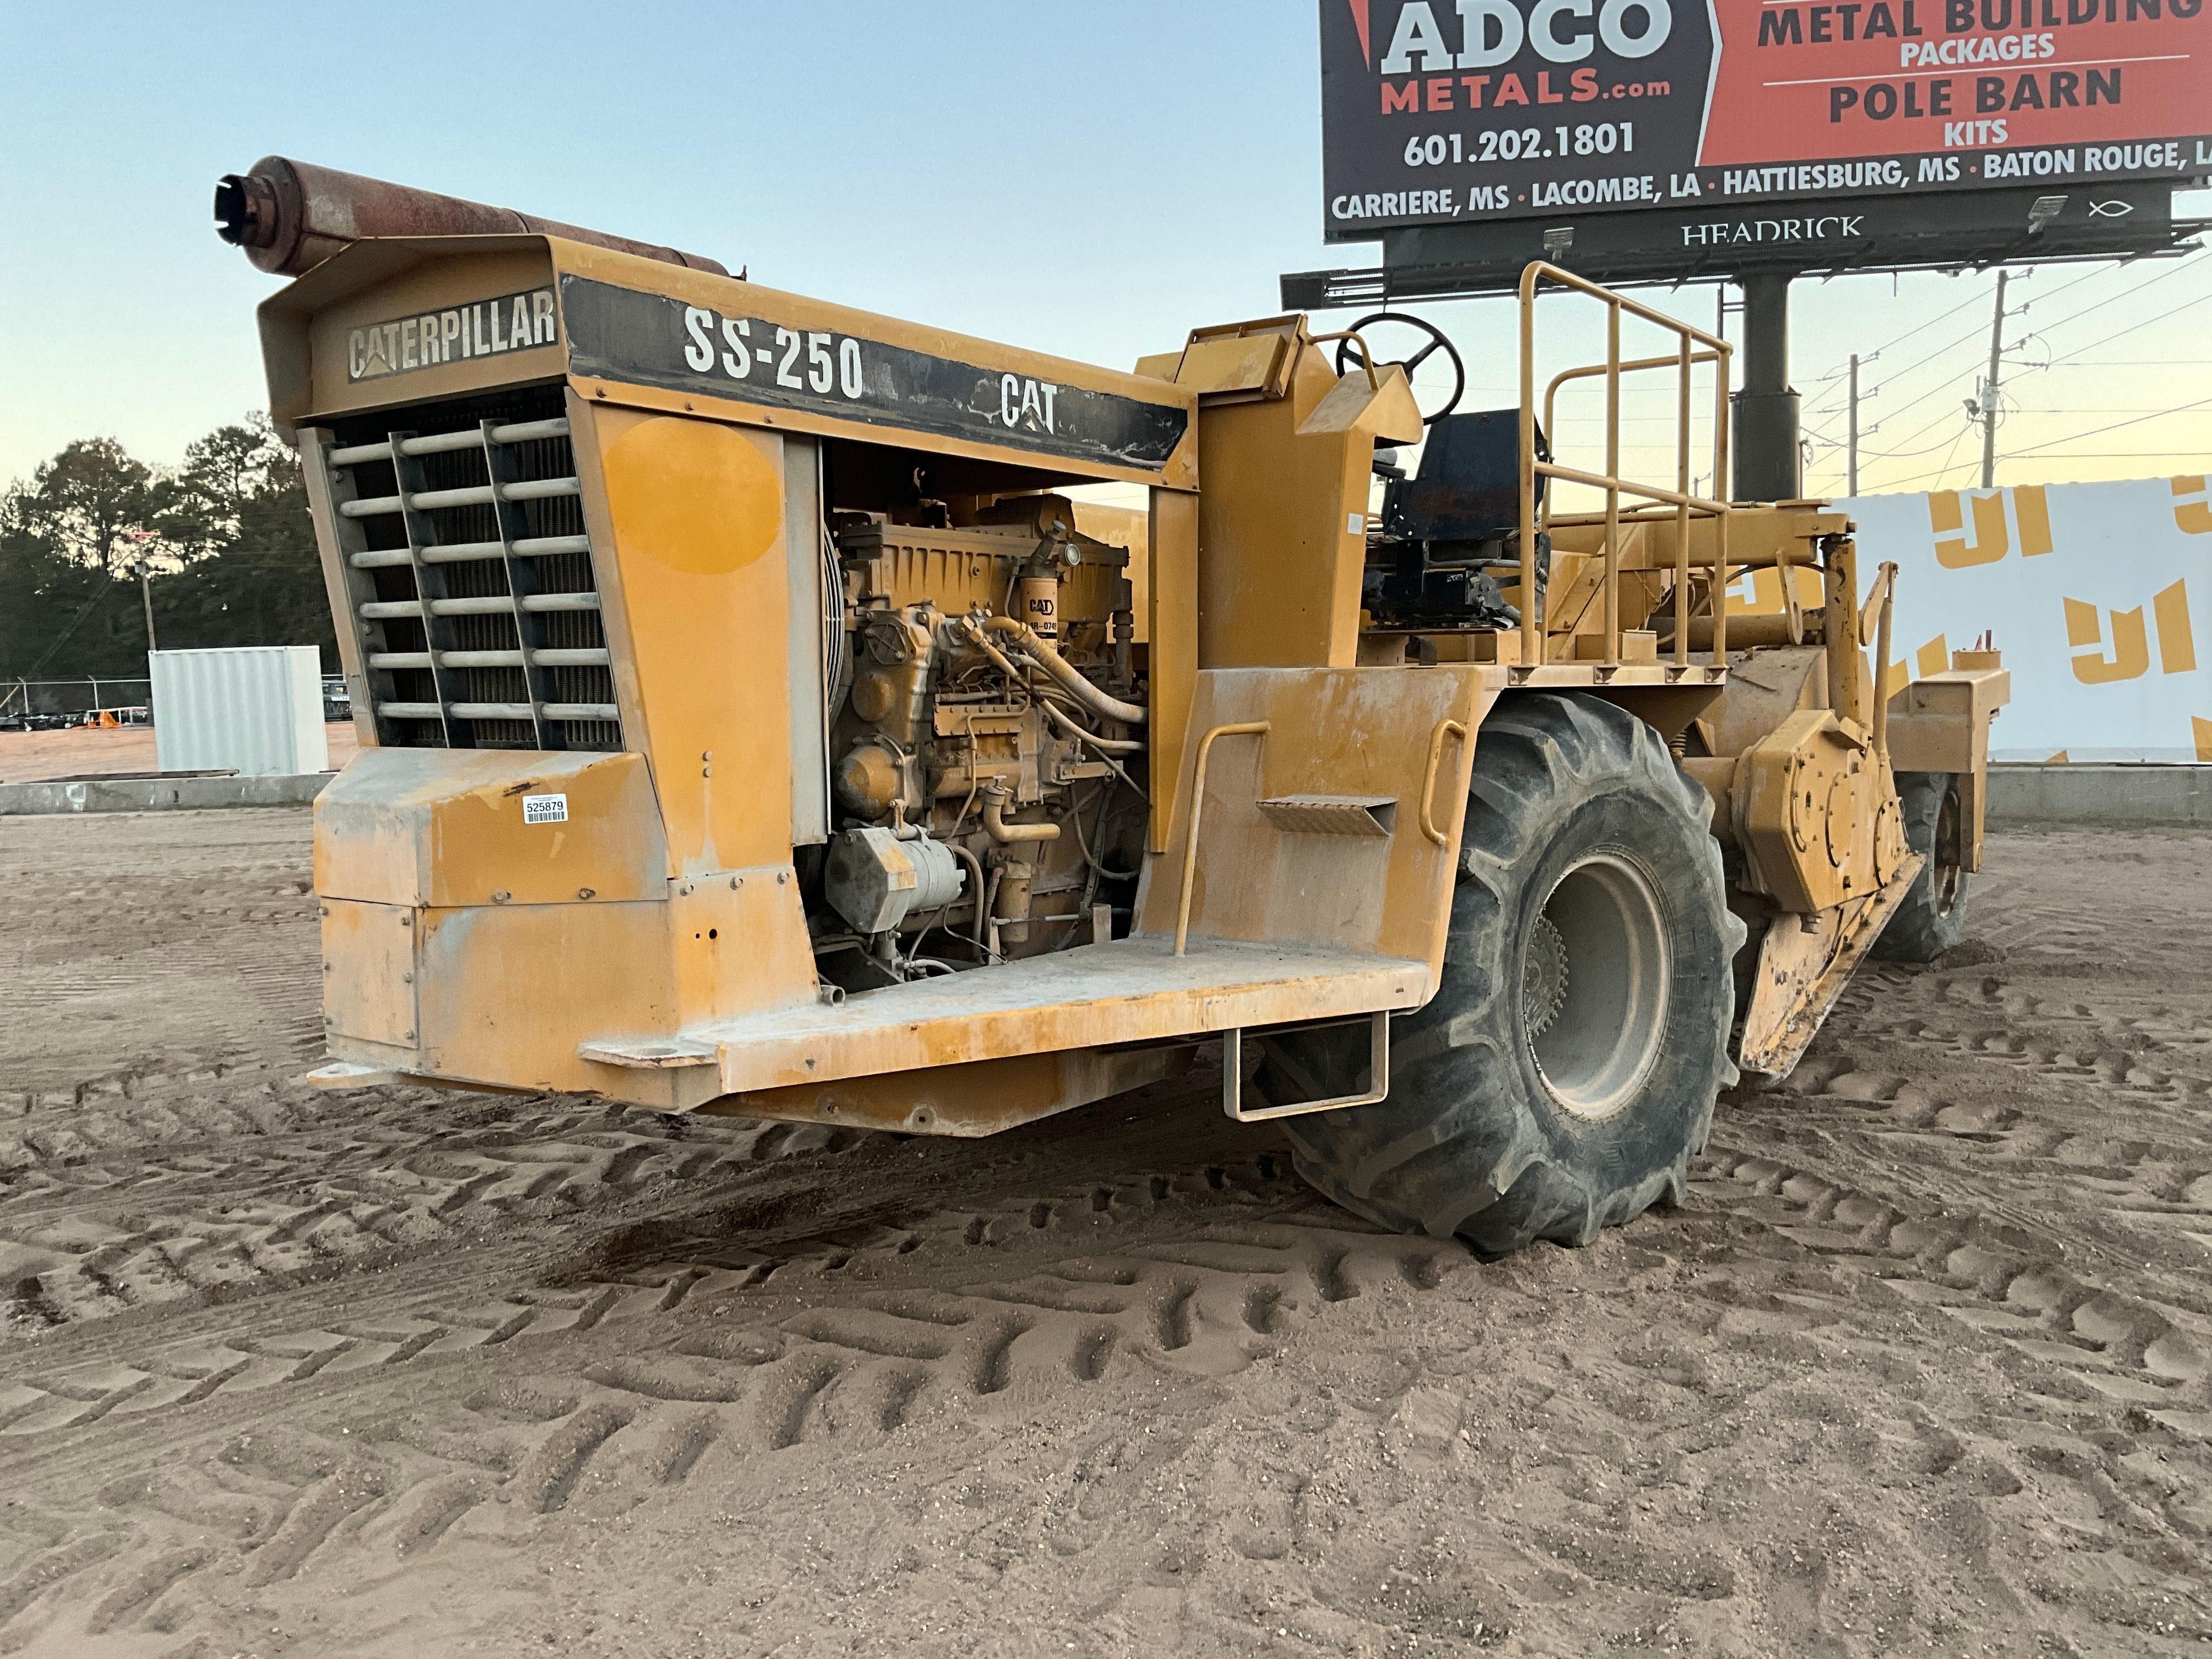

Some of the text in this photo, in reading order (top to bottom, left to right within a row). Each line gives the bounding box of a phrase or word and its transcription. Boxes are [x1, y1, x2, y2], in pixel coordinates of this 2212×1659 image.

[1381, 0, 1672, 74] ADCO
[1758, 0, 1922, 46] METAL
[1901, 33, 2055, 67] PACKAGES
[1381, 68, 1671, 114] METALS.com
[1830, 68, 2121, 123] POLE BARN
[1404, 122, 1633, 166] 601.202.1801
[1945, 119, 2008, 146] KITS
[1331, 189, 1461, 219] CARRIERE,
[1469, 185, 1510, 211] MS
[1532, 176, 1662, 207] LACOMBE,
[1671, 173, 1701, 198] LA
[1723, 160, 1910, 195] HATTIESBURG,
[1918, 157, 1960, 183] MS
[1984, 149, 2075, 178] BATON
[2085, 142, 2187, 172] ROUGE,
[1681, 216, 1864, 246] HEADRICK
[349, 291, 556, 379] CATERPILLAR
[685, 306, 863, 399] SS-250
[1001, 374, 1057, 436] CAT
[1029, 599, 1050, 613] CAT
[527, 801, 563, 812] 525879
